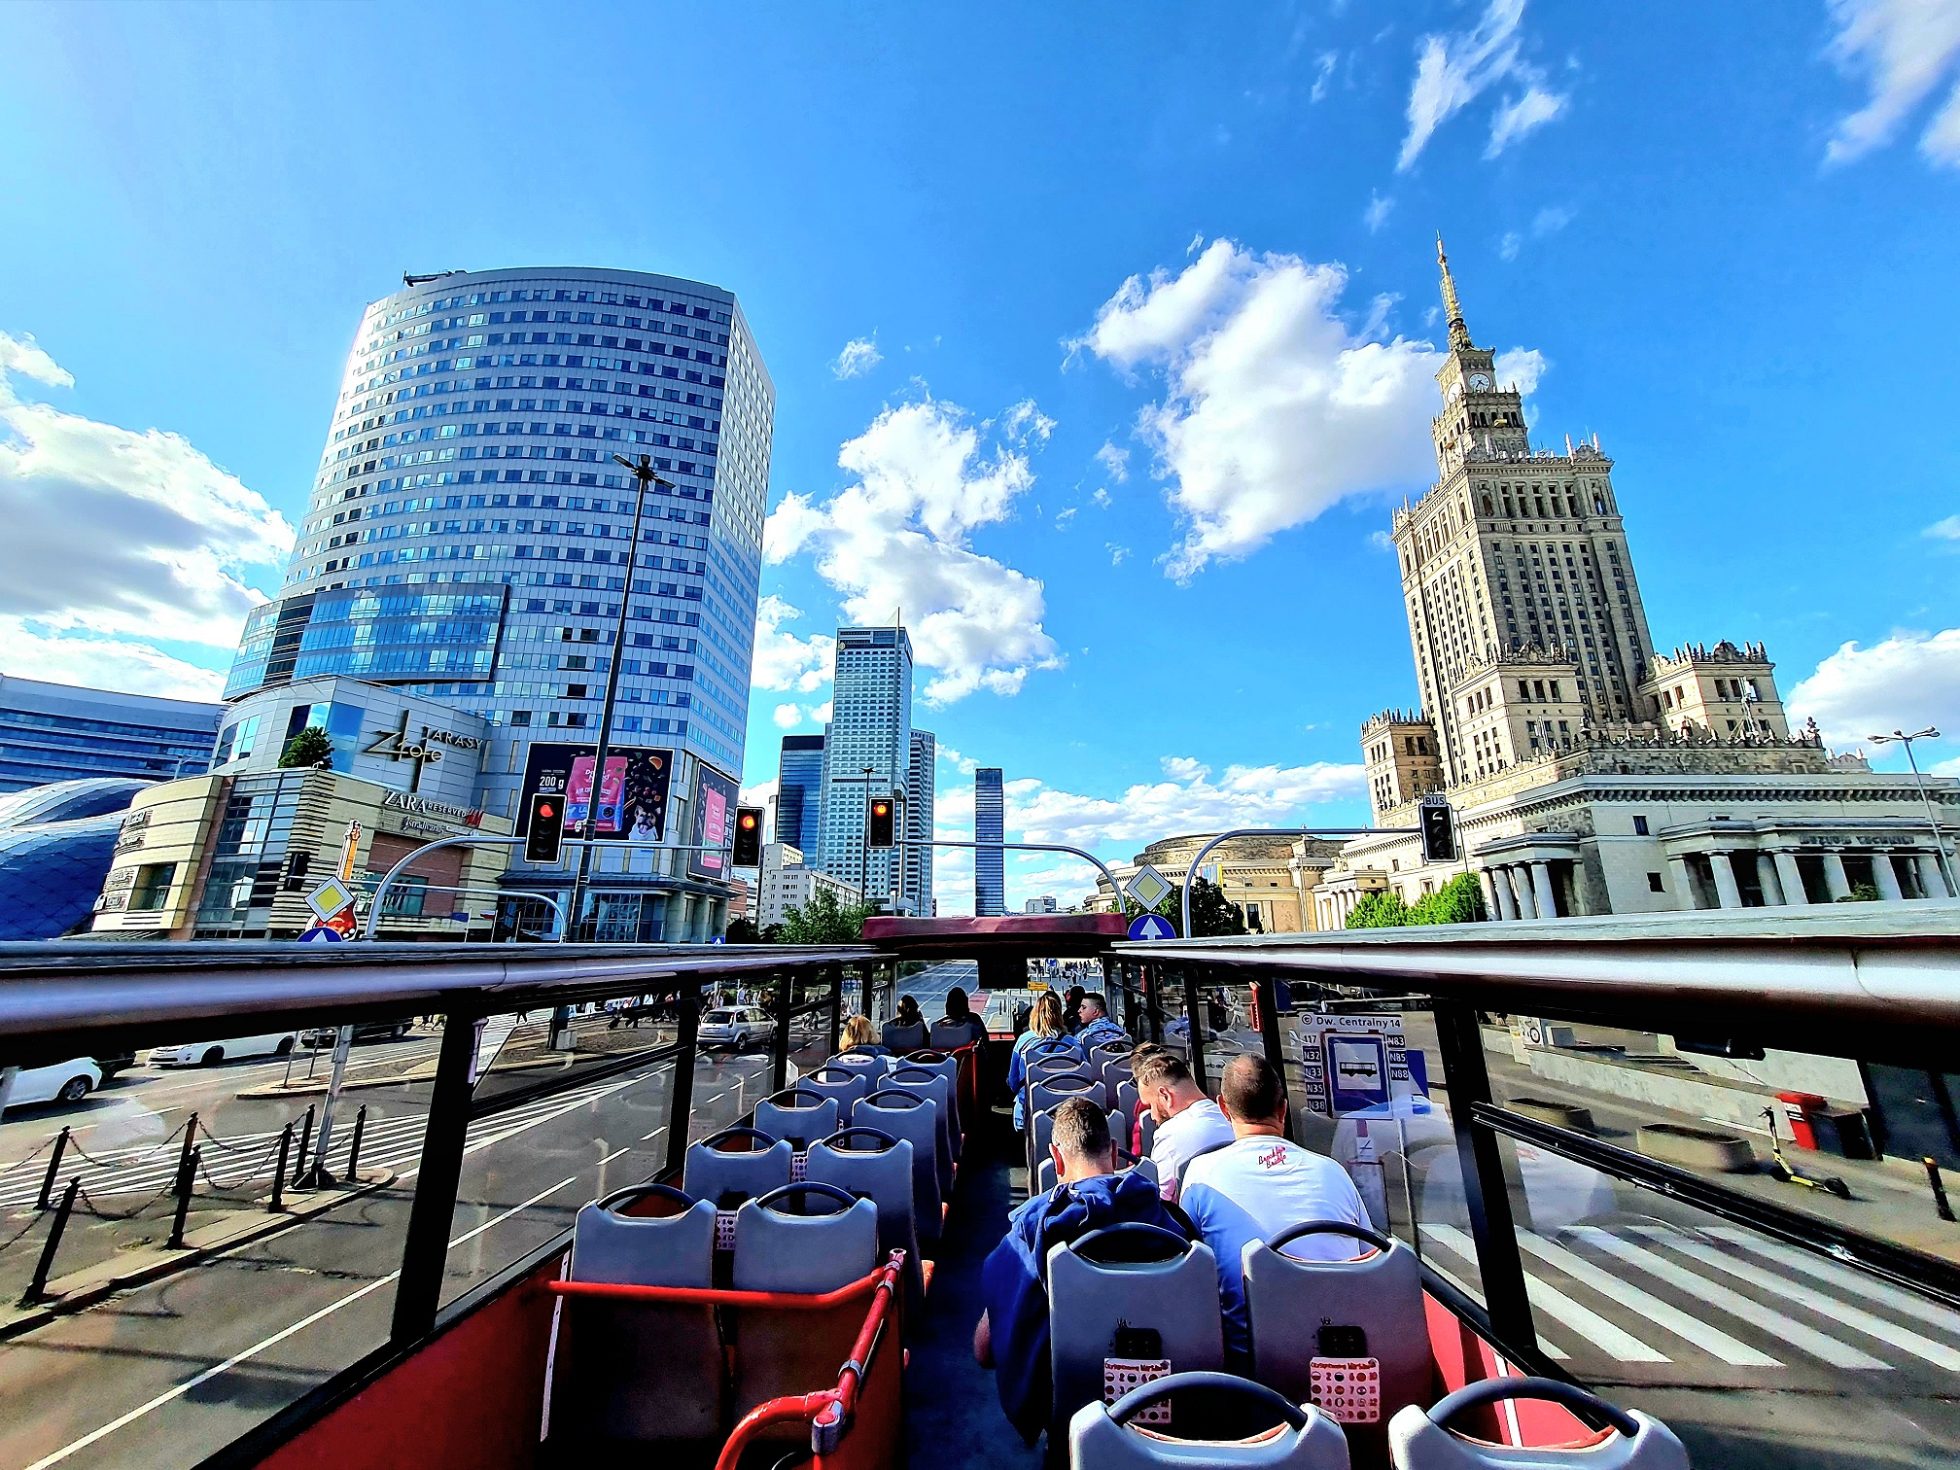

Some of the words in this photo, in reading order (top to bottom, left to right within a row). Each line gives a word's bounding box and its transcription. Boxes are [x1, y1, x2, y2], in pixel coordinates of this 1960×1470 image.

[422, 727, 483, 749] TARASY
[539, 776, 556, 787] 200
[557, 779, 564, 790] g
[384, 790, 427, 814] ZARA
[427, 803, 467, 818] RESERVED
[1425, 796, 1445, 805] BUS
[1316, 1016, 1336, 1026] Dw.
[1340, 1017, 1388, 1029] Centralny
[1390, 1019, 1401, 1028] 14
[1387, 1036, 1405, 1046] N83
[1304, 1051, 1320, 1060] N32
[1389, 1052, 1406, 1062] N85
[1305, 1067, 1321, 1077] N33
[1306, 1084, 1323, 1093] N35
